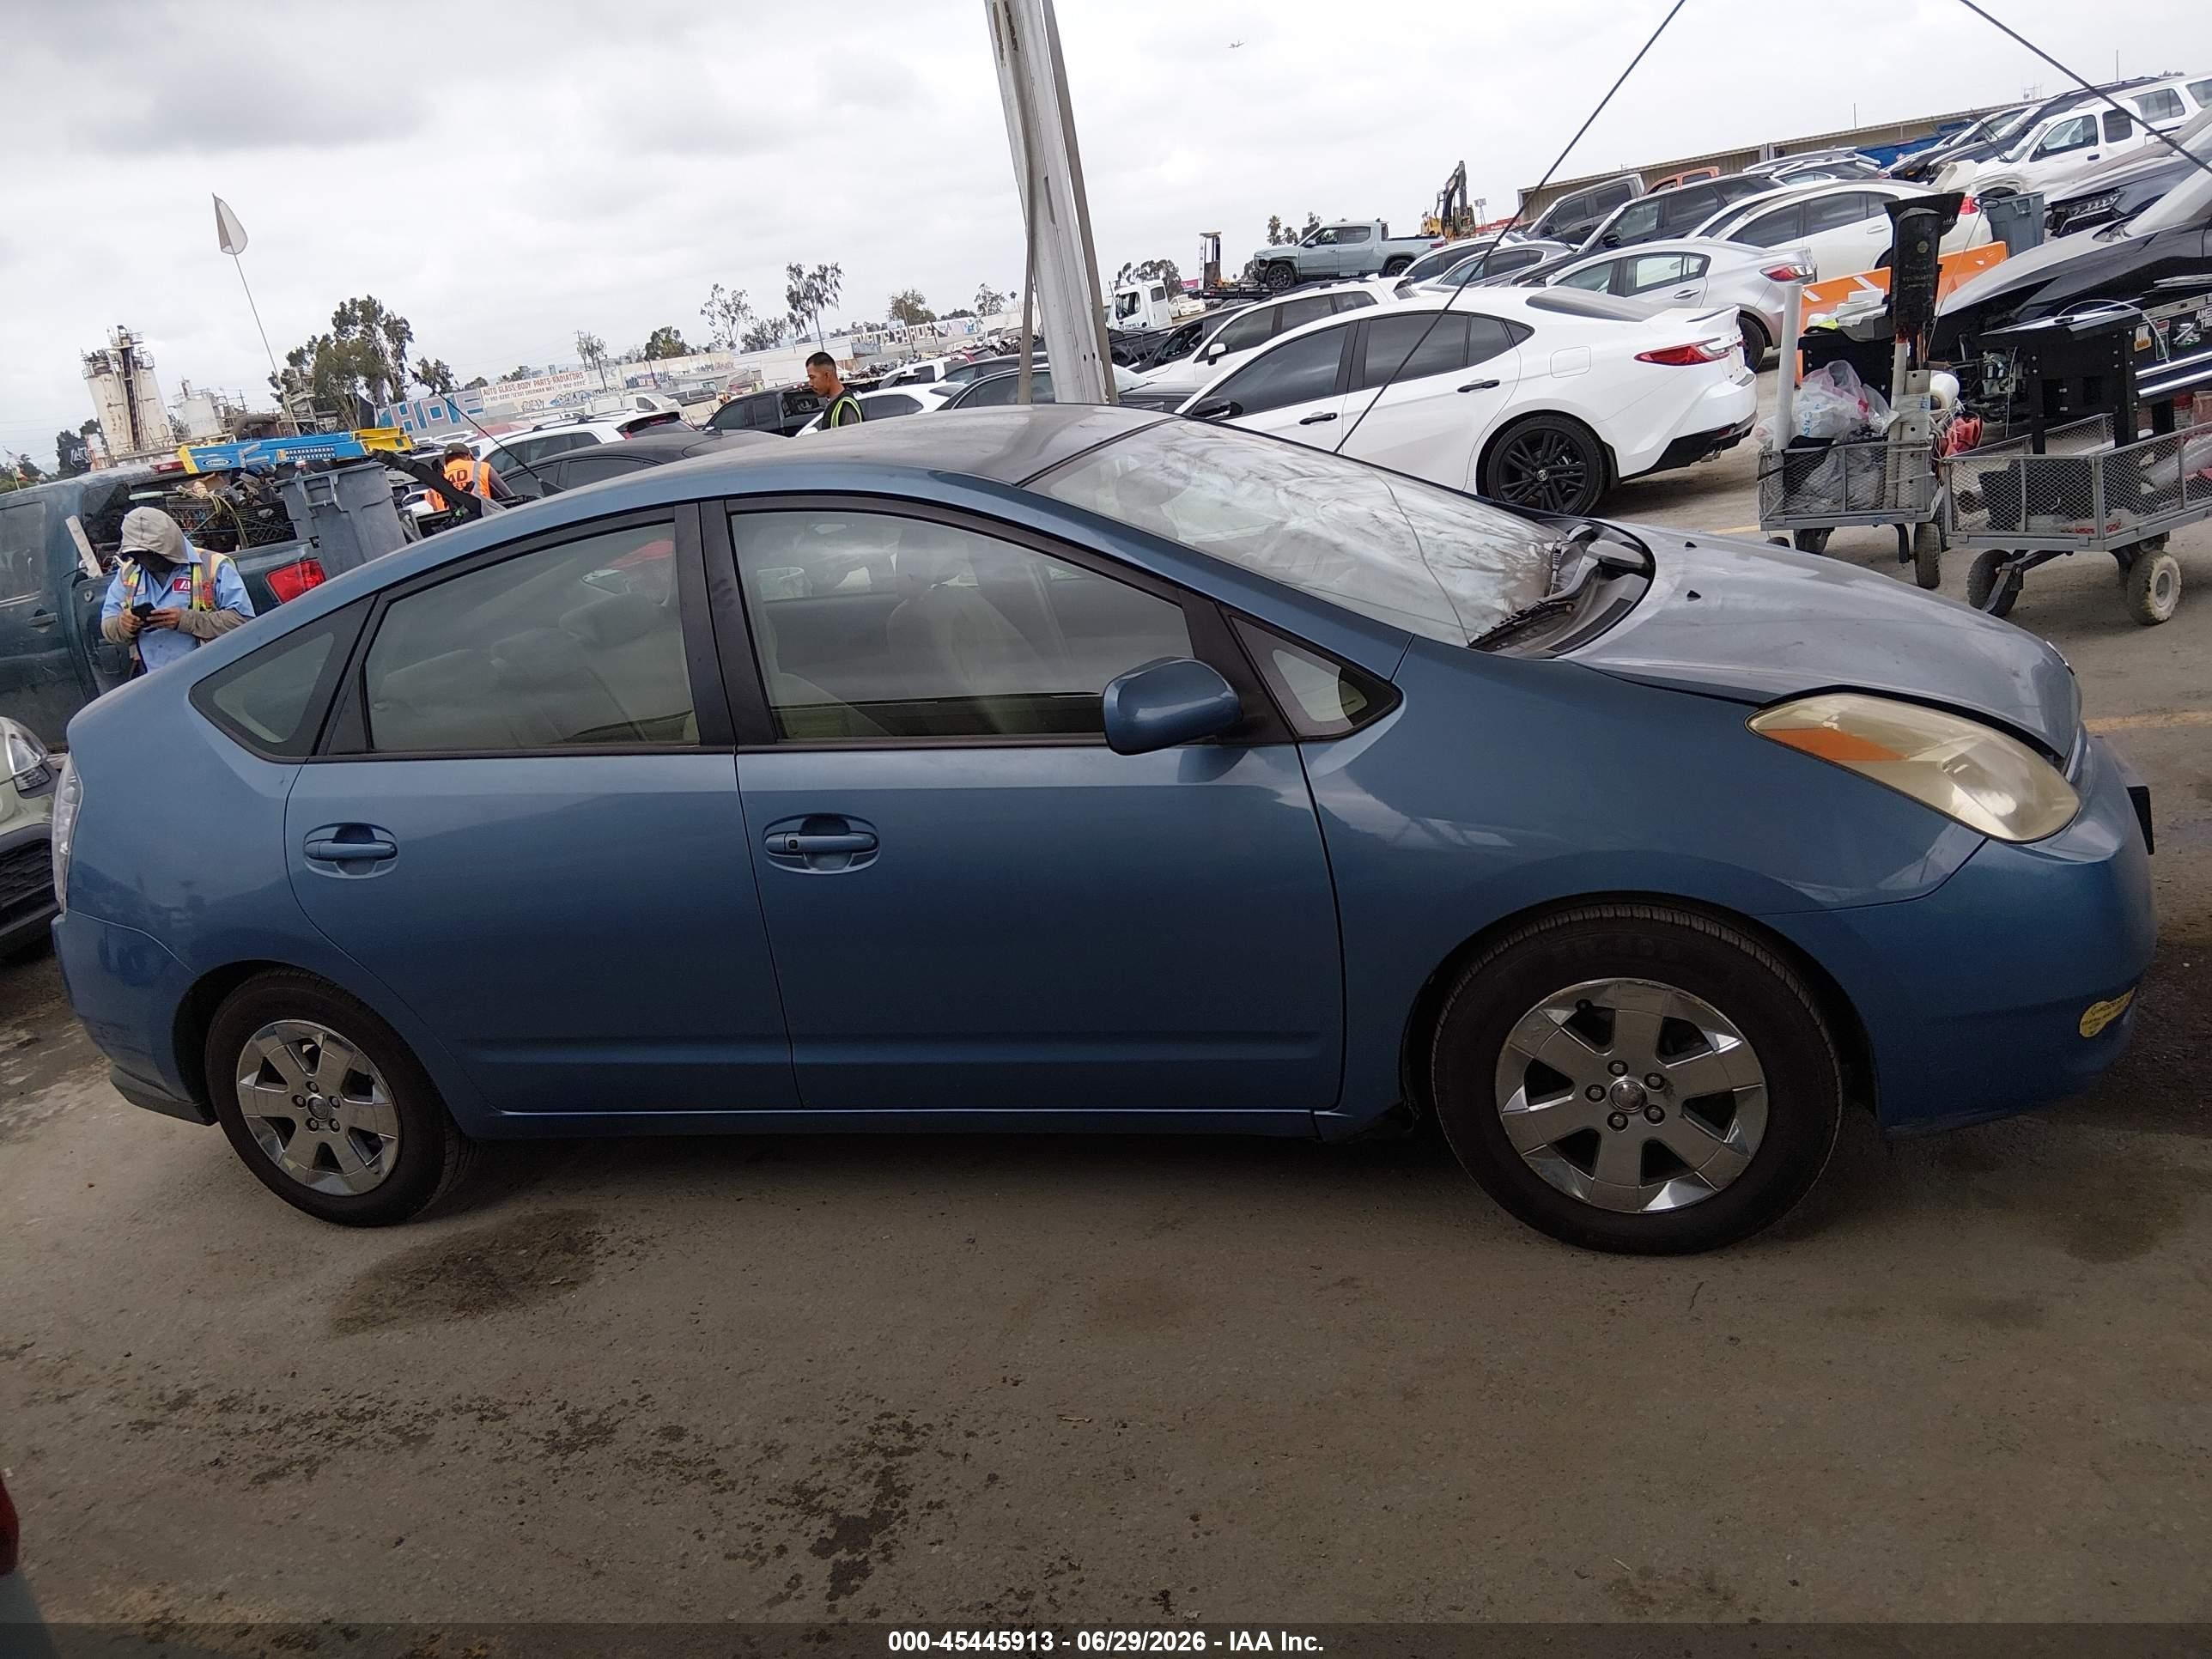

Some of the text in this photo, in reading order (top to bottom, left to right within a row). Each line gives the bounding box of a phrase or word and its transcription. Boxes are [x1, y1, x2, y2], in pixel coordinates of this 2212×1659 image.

[498, 385, 515, 394] GLASS
[518, 382, 532, 392] BODY
[533, 379, 550, 389] PARTS
[552, 372, 584, 384] RADIATORS
